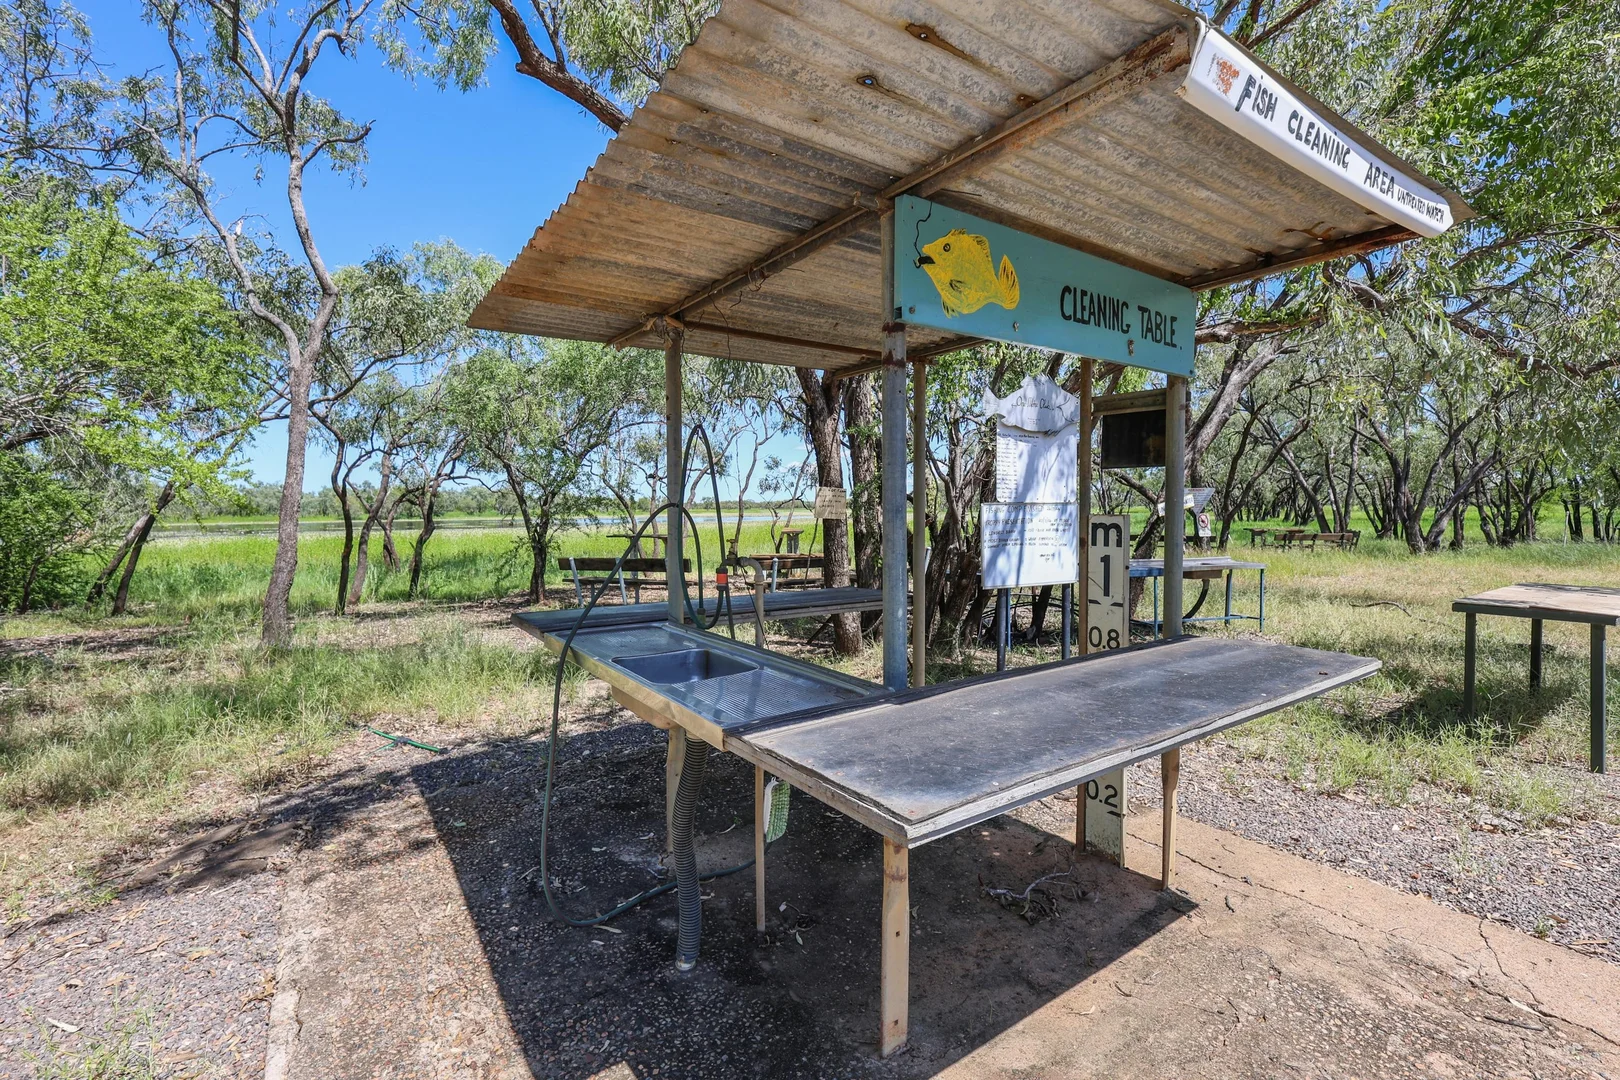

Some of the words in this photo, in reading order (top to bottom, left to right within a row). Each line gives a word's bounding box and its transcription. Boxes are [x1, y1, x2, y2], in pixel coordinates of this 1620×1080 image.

[1235, 74, 1278, 122] FISH
[1288, 109, 1351, 172] CLEANING
[1364, 162, 1396, 197] AREA
[1060, 285, 1131, 335] CLEANING
[1091, 522, 1123, 548] m
[1100, 554, 1111, 597] 1
[1089, 626, 1120, 650] 0.8
[1086, 779, 1118, 808] 0.2
